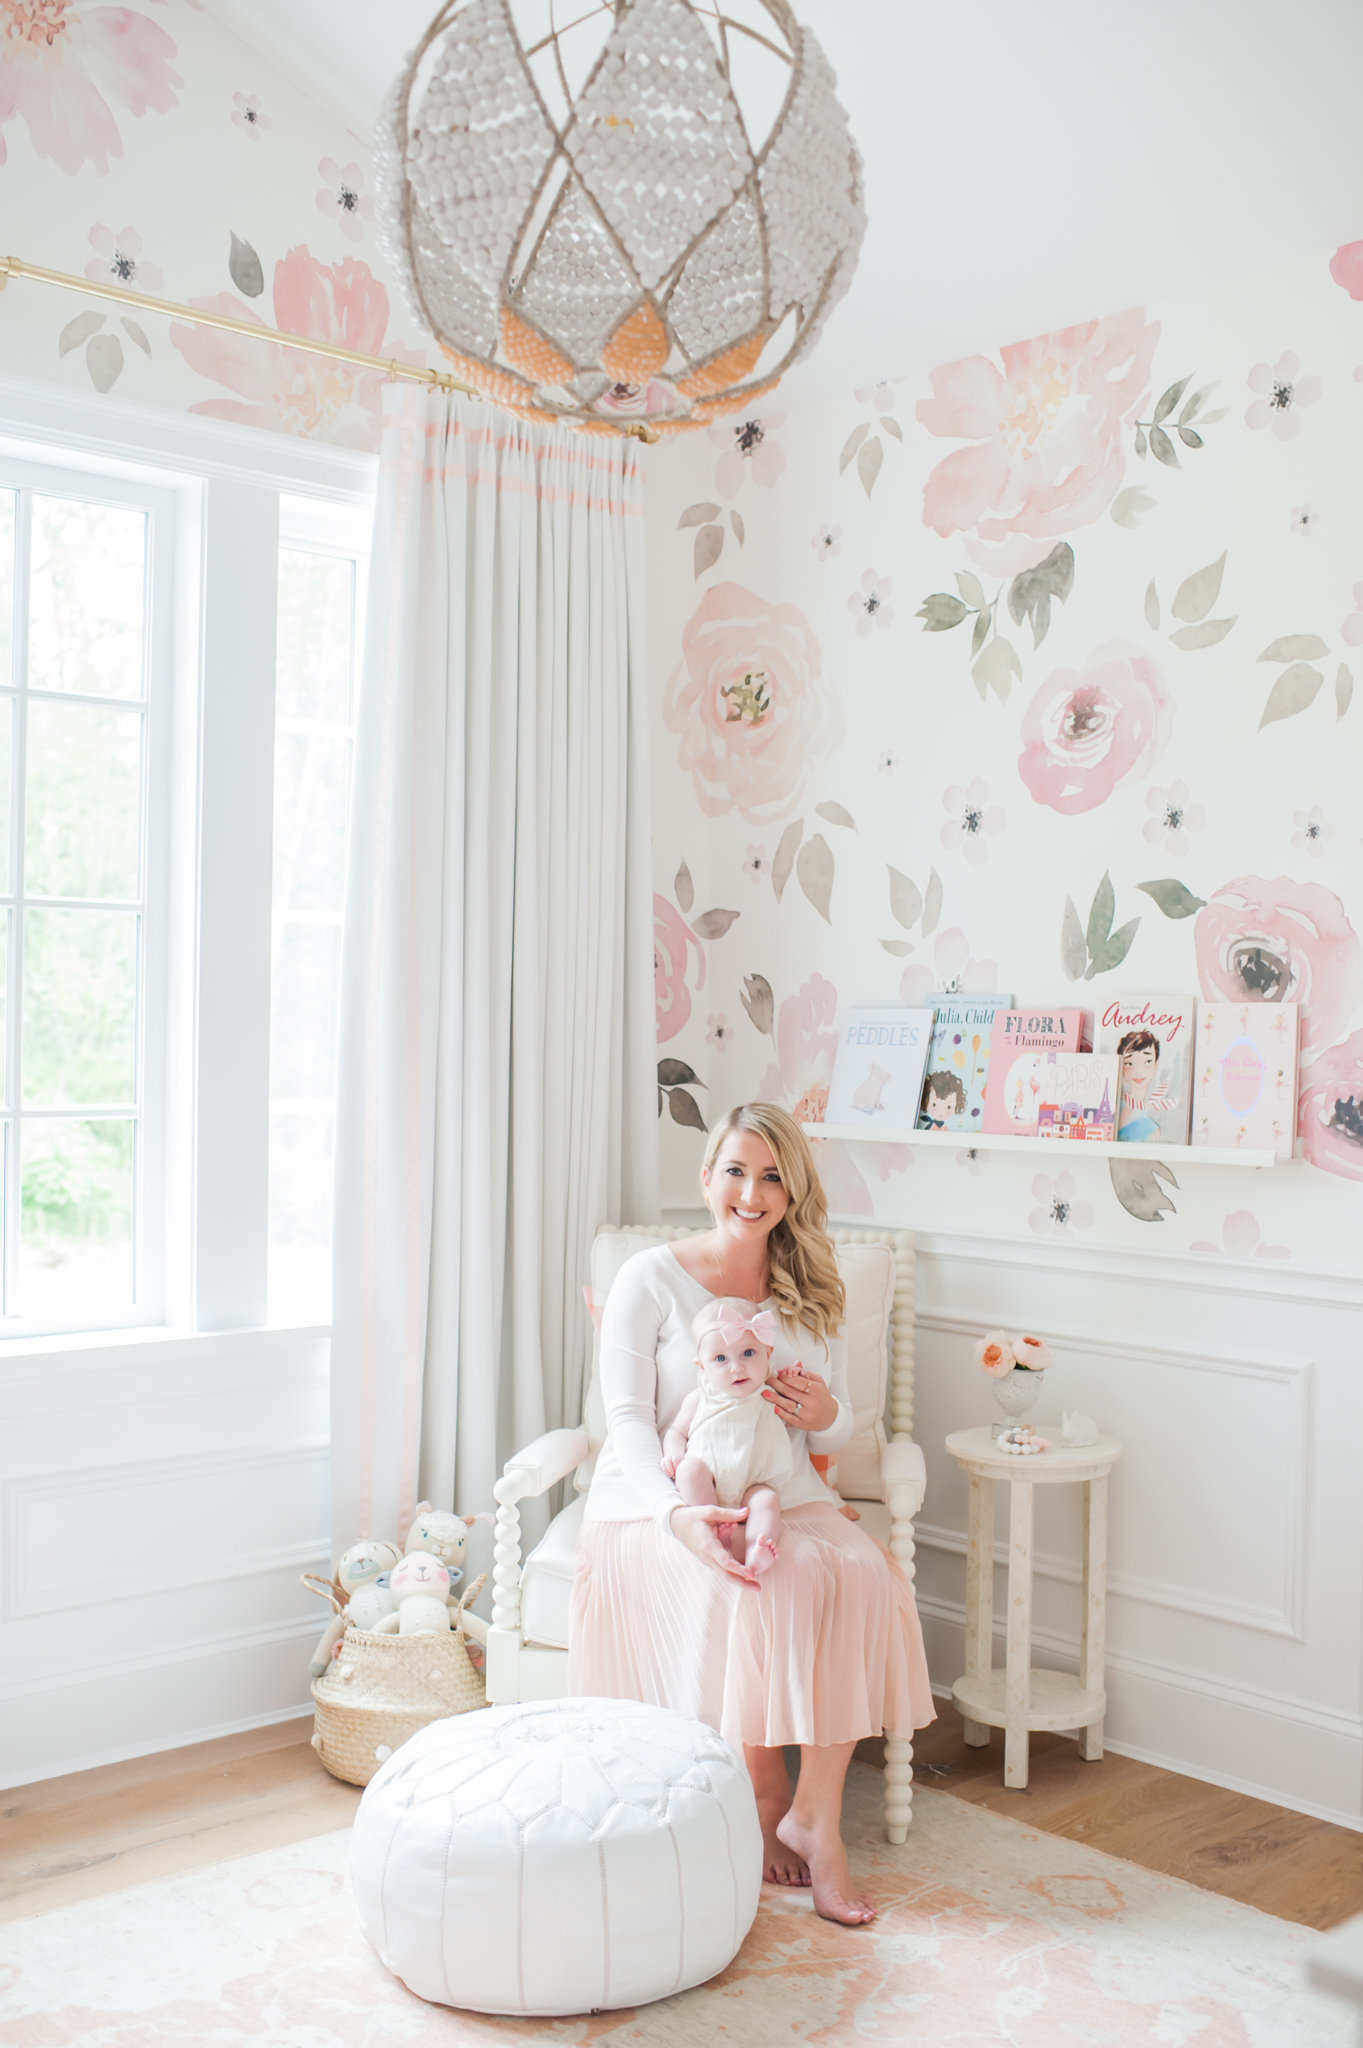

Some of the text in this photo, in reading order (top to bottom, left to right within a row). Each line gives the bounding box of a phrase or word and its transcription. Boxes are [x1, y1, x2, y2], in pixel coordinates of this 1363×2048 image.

[966, 1008, 994, 1025] Child
[1005, 1016, 1066, 1033] FLORA
[1102, 1001, 1185, 1042] Audrey
[846, 1026, 919, 1046] PEDDLES
[1015, 1035, 1065, 1048] Flamingo
[1050, 1059, 1104, 1102] PARIS
